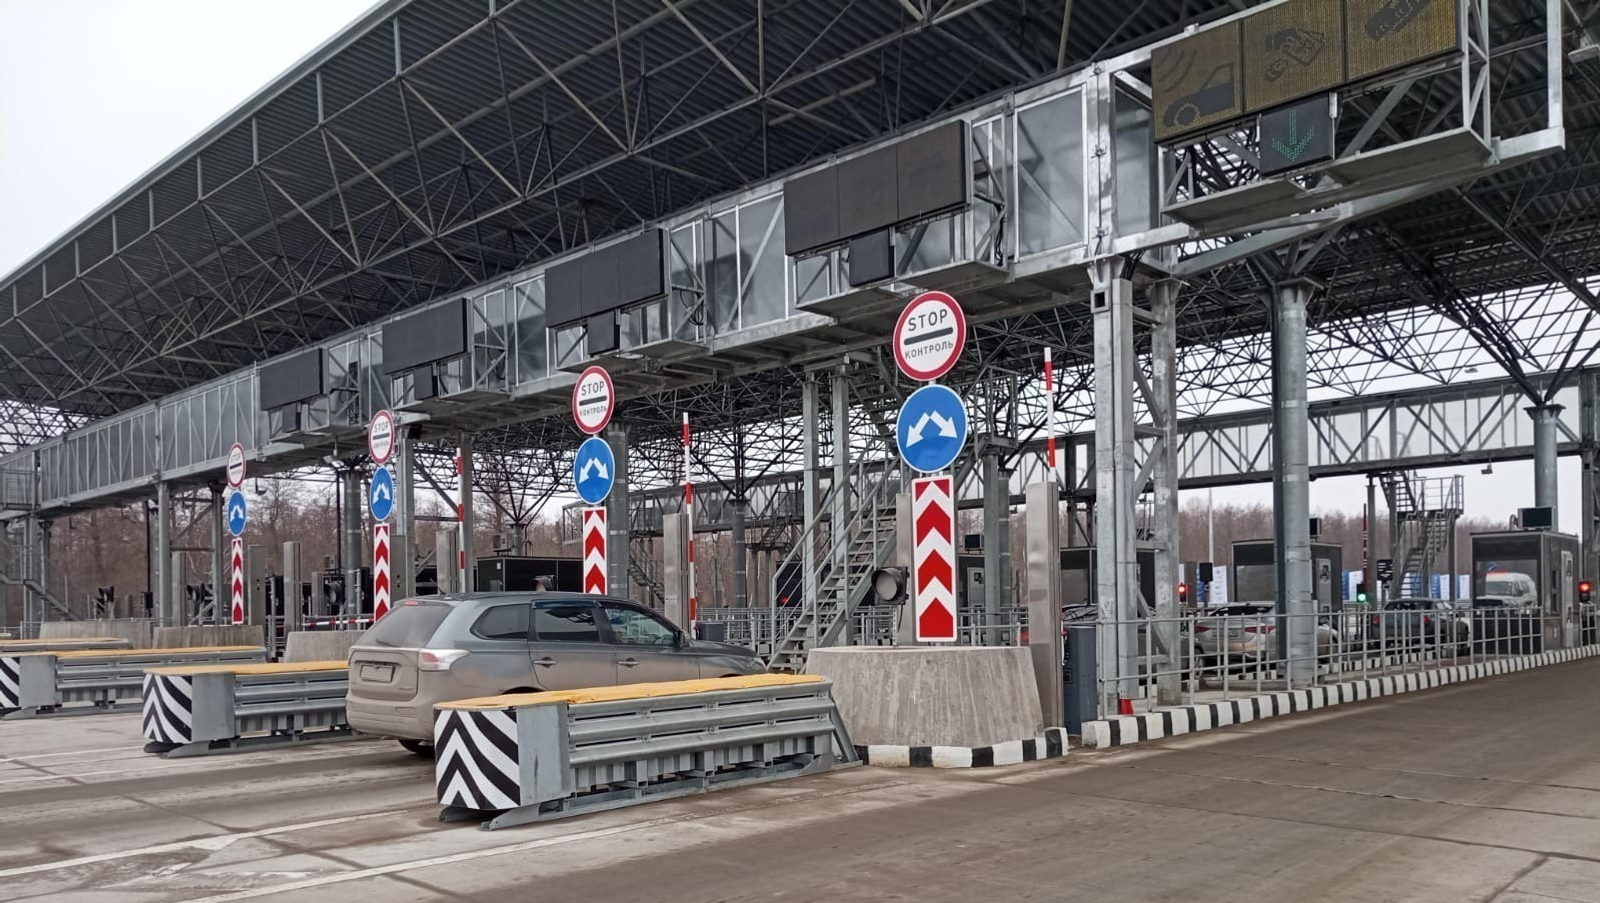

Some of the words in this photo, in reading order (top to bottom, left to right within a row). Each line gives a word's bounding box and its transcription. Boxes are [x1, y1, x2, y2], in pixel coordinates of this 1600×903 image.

[908, 309, 948, 331] STOP
[905, 340, 954, 359] КОНТРОЛЬ
[581, 381, 605, 396] STOP
